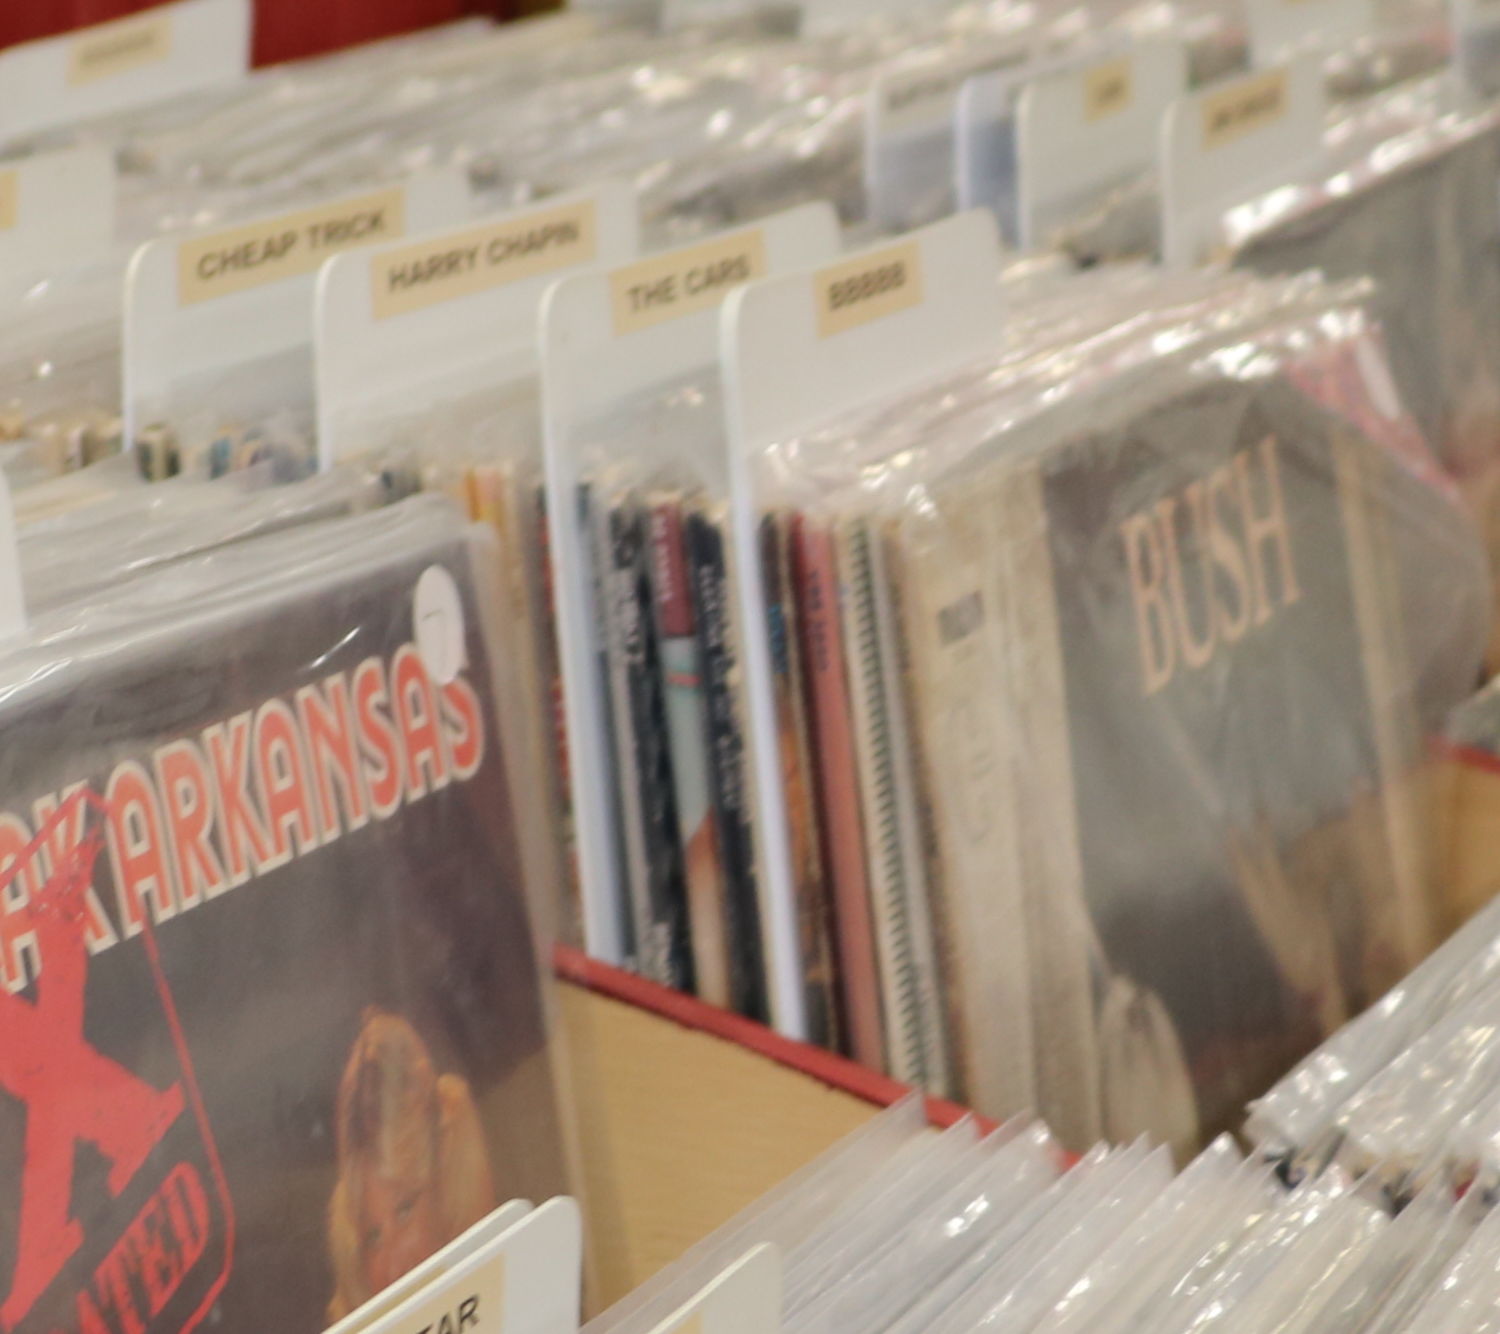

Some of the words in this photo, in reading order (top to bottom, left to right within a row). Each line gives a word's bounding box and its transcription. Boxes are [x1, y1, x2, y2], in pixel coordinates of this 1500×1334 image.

[195, 227, 299, 280] CHEAP
[307, 206, 387, 253] TRICK
[387, 241, 480, 294] HARRY
[488, 214, 583, 268] CHAPIN
[626, 269, 683, 315] THE
[1119, 431, 1303, 699] BUSH
[103, 642, 487, 939] ARKANSAS
